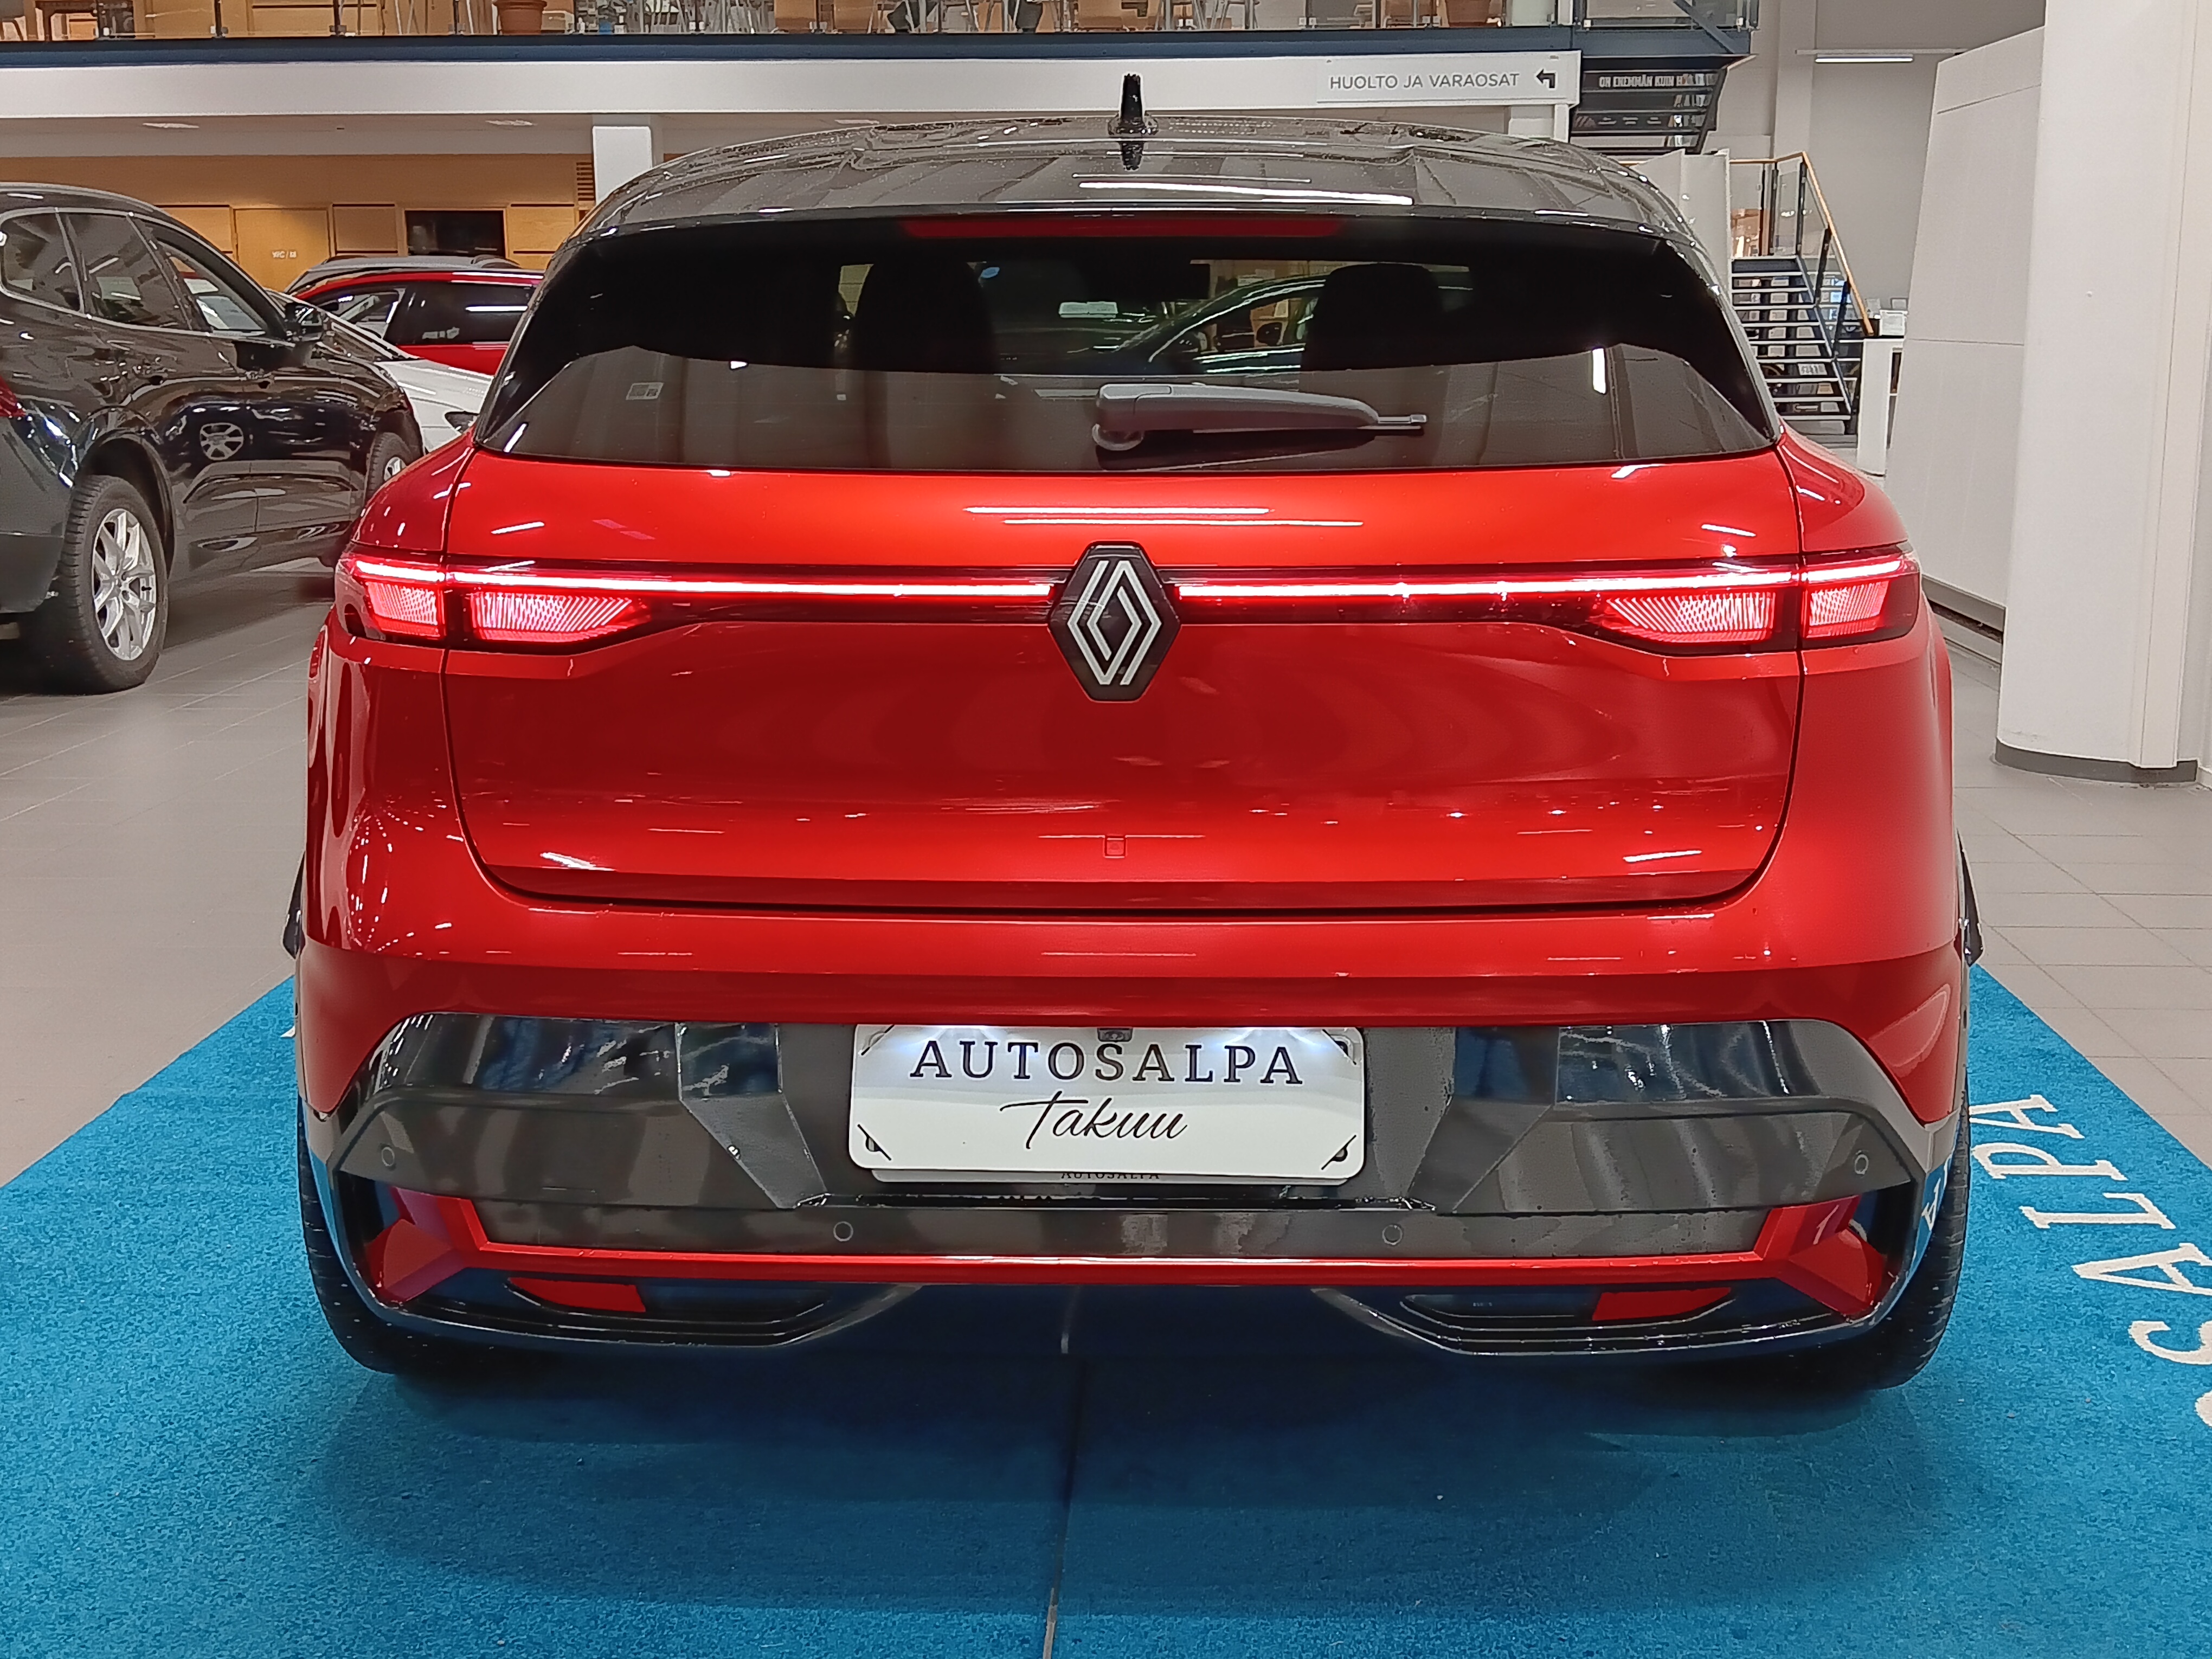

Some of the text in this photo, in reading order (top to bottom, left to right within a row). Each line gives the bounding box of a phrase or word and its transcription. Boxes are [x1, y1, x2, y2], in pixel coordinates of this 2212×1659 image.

[1330, 73, 1520, 89] HUOLTO JA VARAOSAT
[909, 1040, 1303, 1084] AUTOSALPA
[999, 1090, 1188, 1149] Takuu
